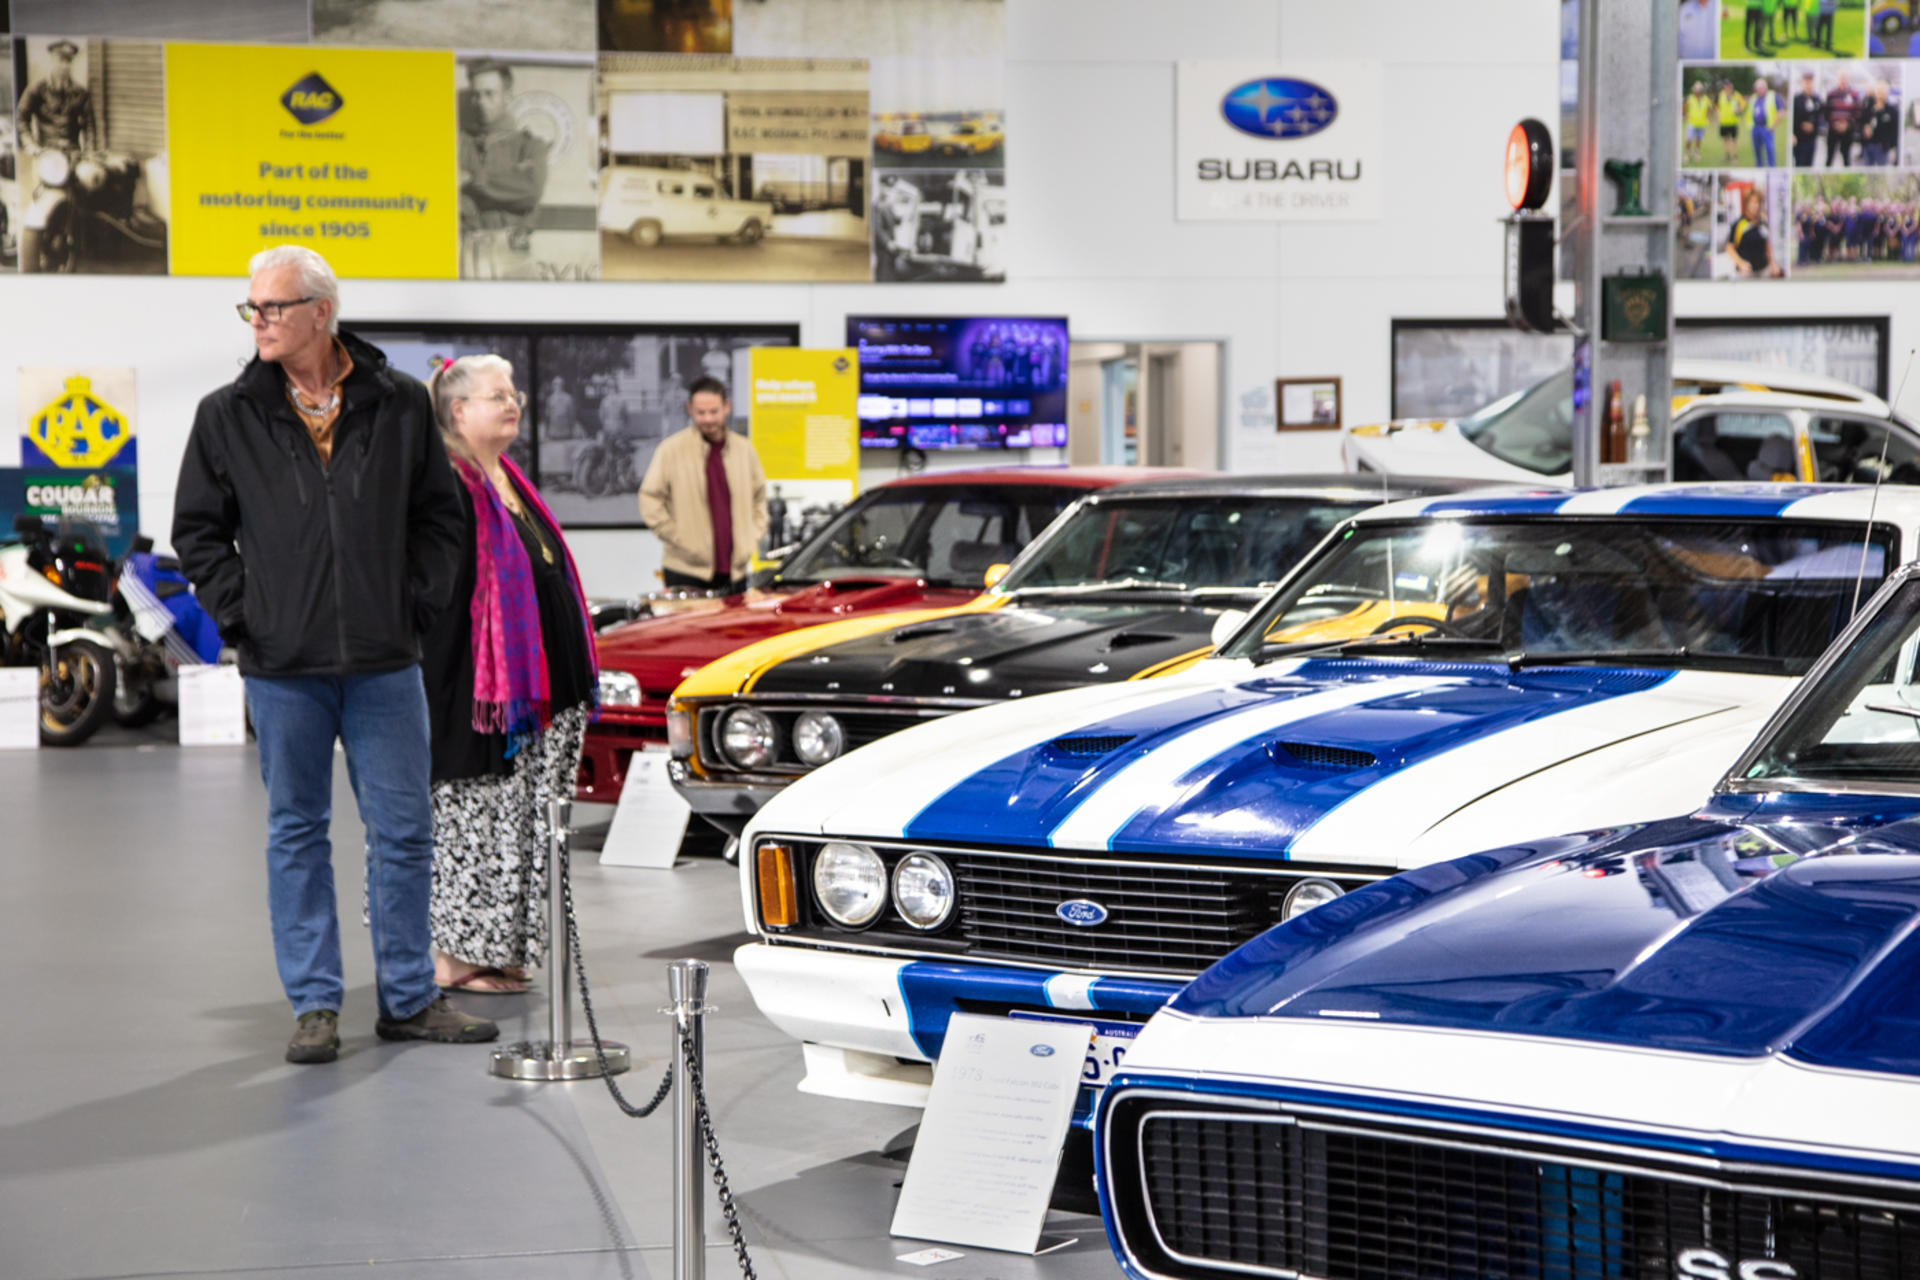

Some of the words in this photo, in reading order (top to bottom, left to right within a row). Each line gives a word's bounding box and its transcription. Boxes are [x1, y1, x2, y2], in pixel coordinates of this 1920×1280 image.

[289, 91, 335, 110] RAC
[259, 162, 304, 179] Part
[309, 163, 329, 179] of
[334, 164, 368, 180] the
[1198, 159, 1361, 181] SUBARU
[200, 191, 301, 211] motoring
[306, 194, 427, 214] community
[1257, 192, 1286, 208] THE
[1291, 192, 1350, 209] DRIVER
[260, 219, 314, 237] since
[319, 221, 370, 238] 1905
[41, 397, 121, 454] RAC
[26, 484, 115, 507] COUGAR
[1068, 903, 1096, 920] Ford
[1105, 1030, 1137, 1039] AUSTRALI
